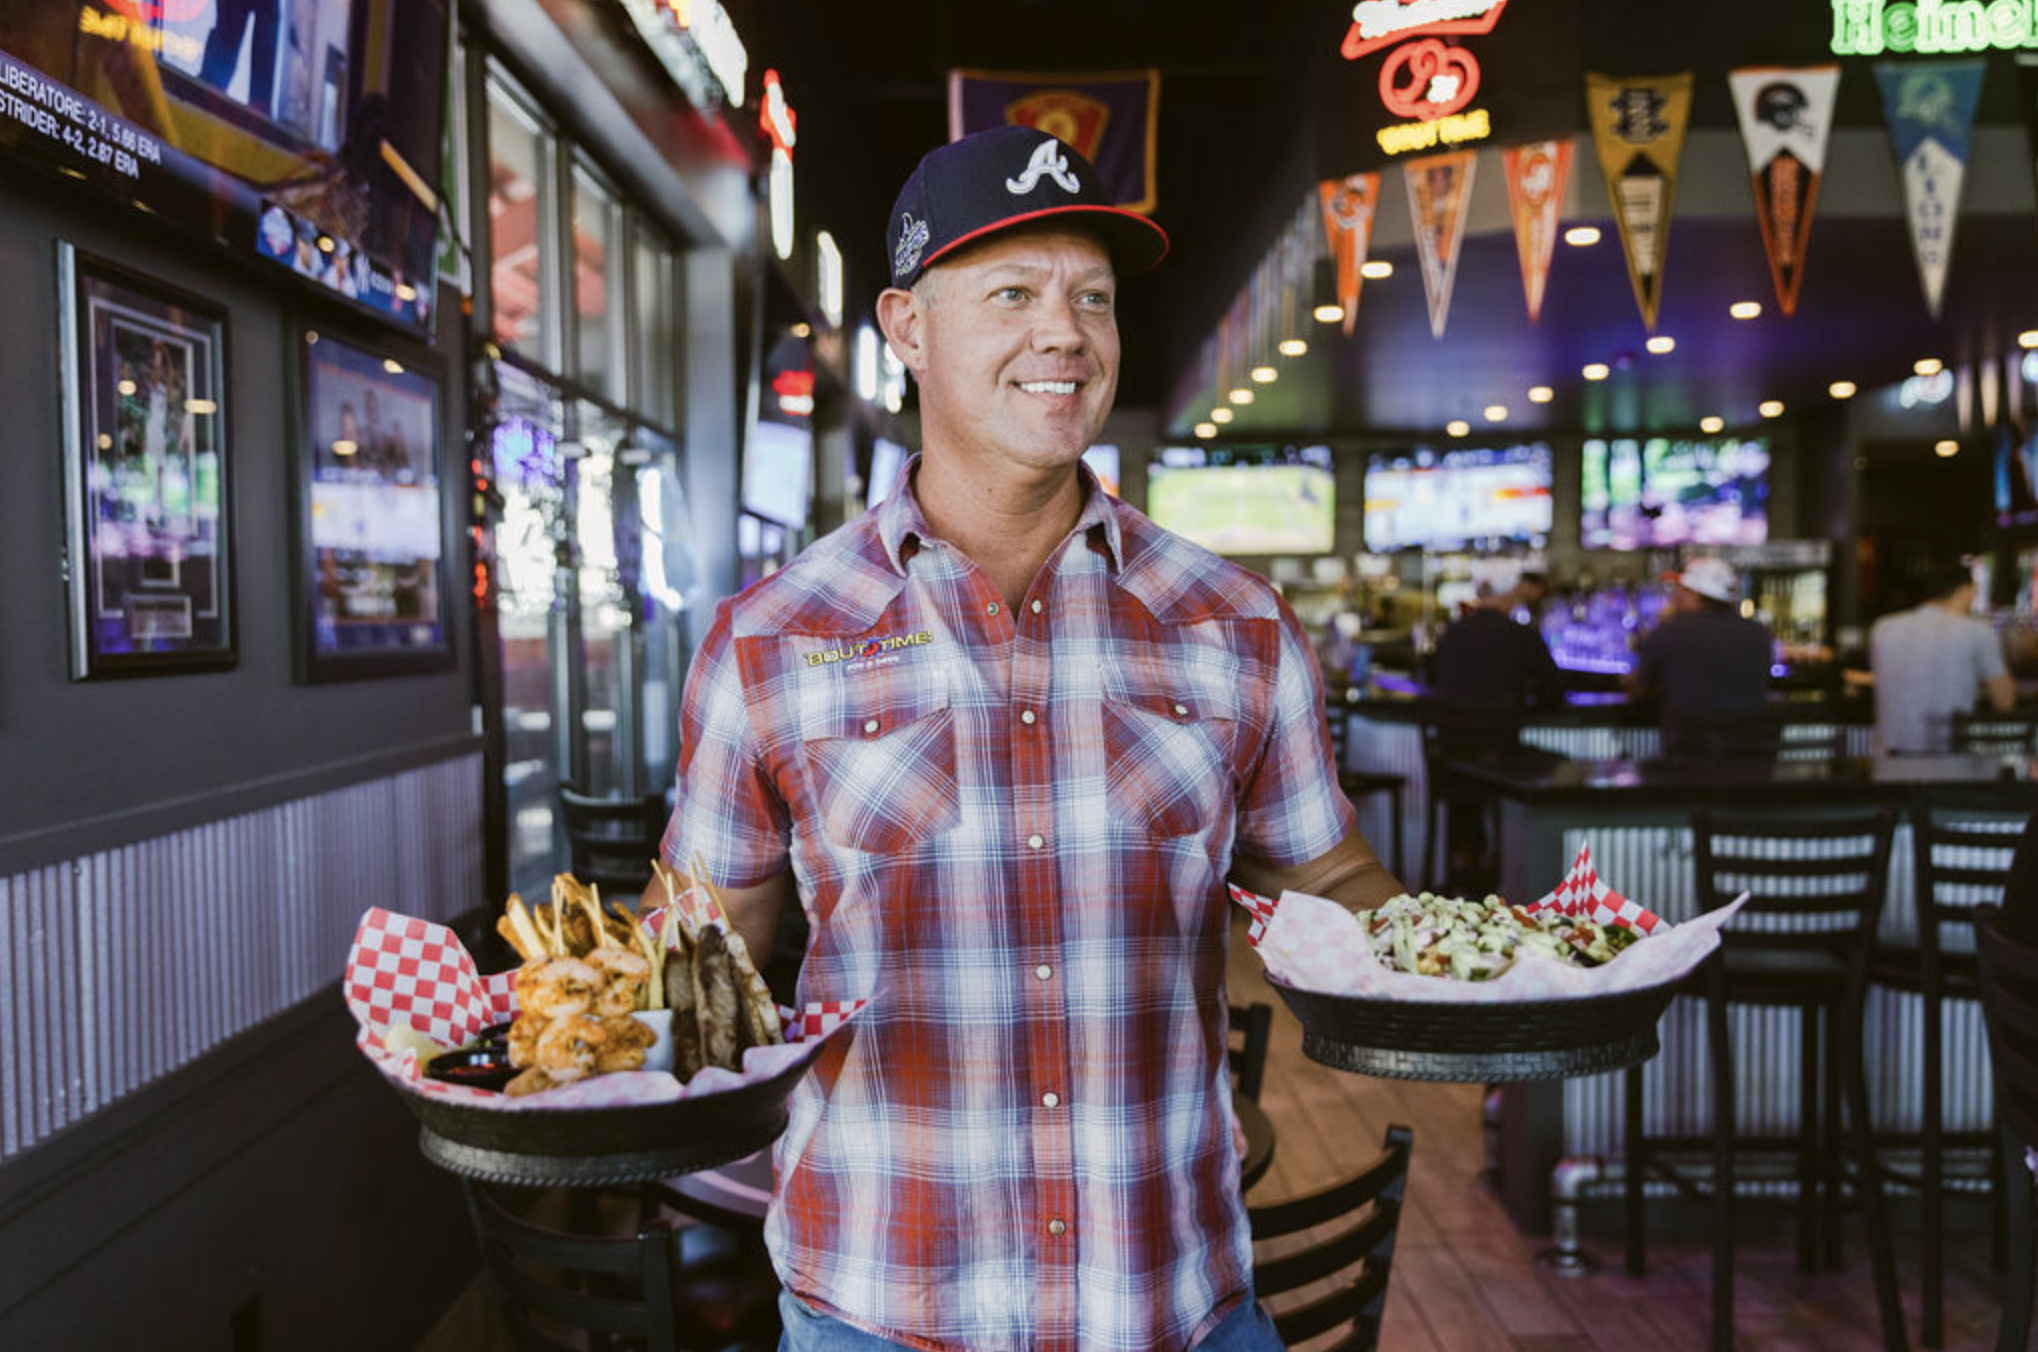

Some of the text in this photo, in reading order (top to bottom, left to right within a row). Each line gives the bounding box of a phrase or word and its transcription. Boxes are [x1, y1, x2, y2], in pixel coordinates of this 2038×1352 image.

[114, 149, 139, 179] ERA
[137, 134, 161, 165] ERA
[1006, 139, 1080, 194] A
